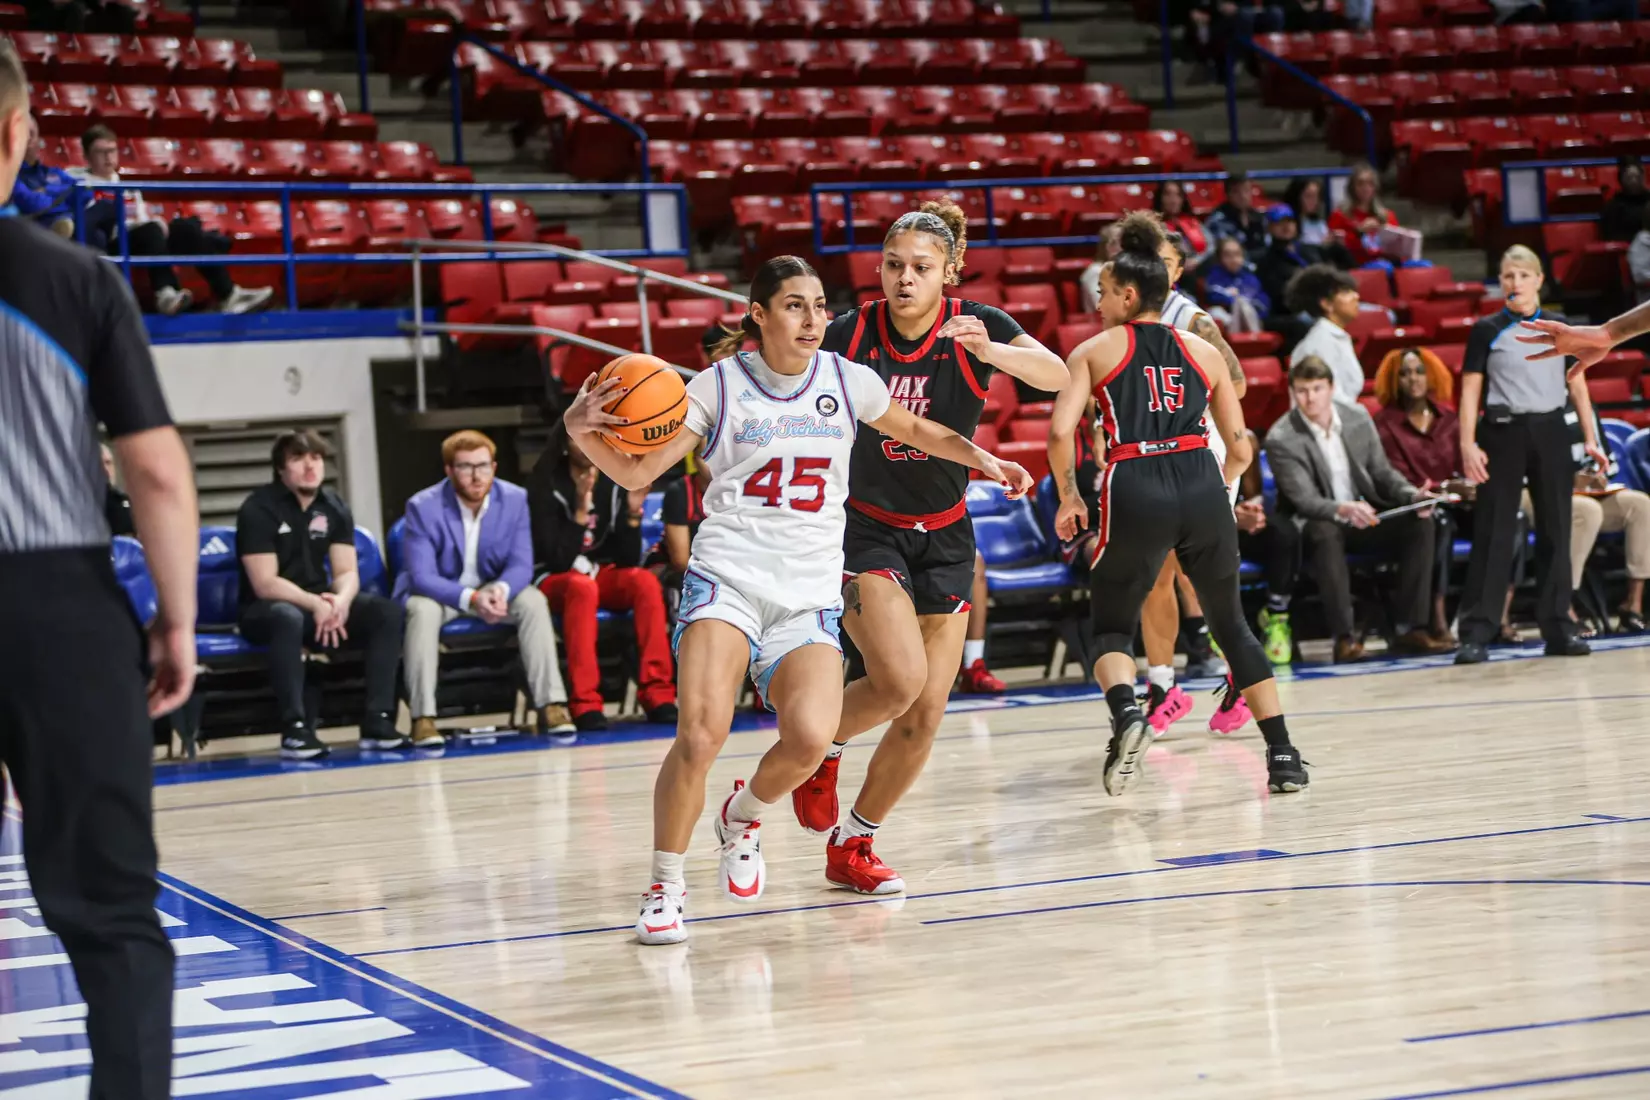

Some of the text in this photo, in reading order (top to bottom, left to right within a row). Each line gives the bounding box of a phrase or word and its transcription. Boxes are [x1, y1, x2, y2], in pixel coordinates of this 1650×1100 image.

[1143, 366, 1185, 413] 15
[734, 414, 844, 447] Lady Techsters
[742, 456, 832, 513] 45
